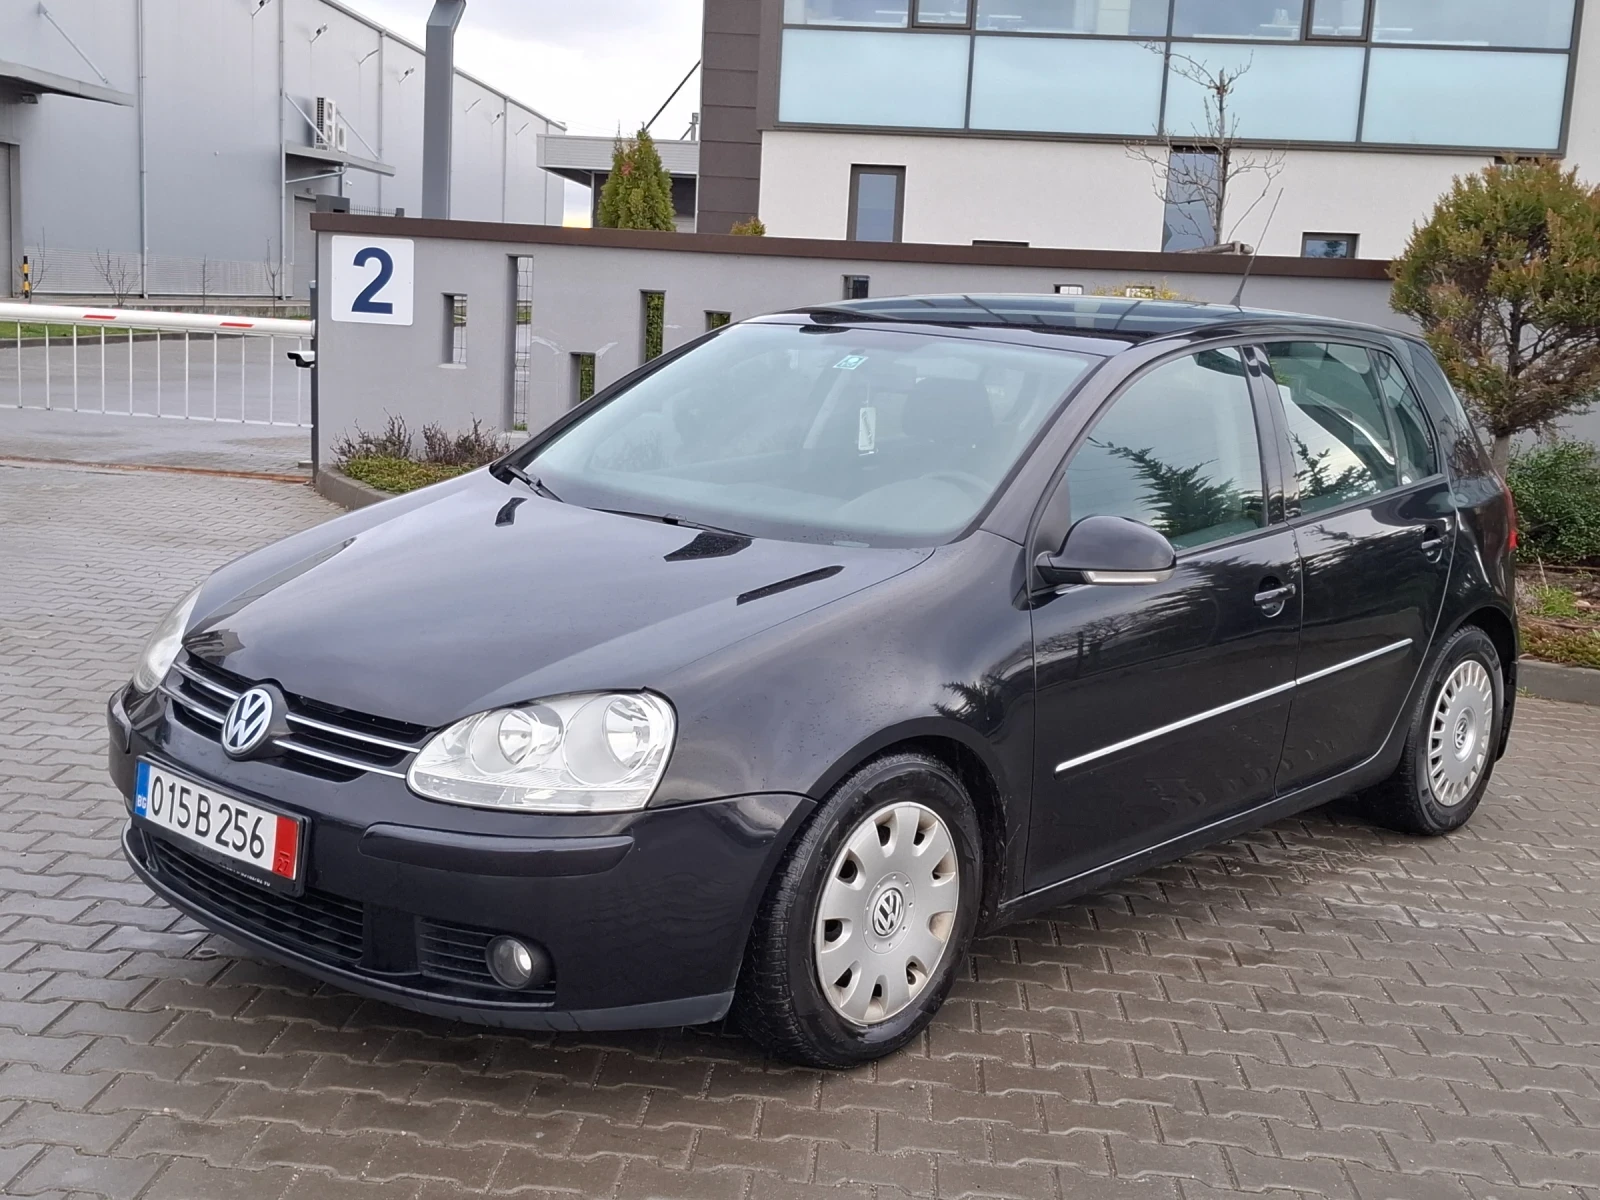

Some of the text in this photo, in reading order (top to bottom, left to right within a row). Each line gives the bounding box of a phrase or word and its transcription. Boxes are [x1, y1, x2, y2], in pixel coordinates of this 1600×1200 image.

[351, 246, 394, 314] 2
[222, 688, 273, 755] VW
[136, 794, 147, 810] BG
